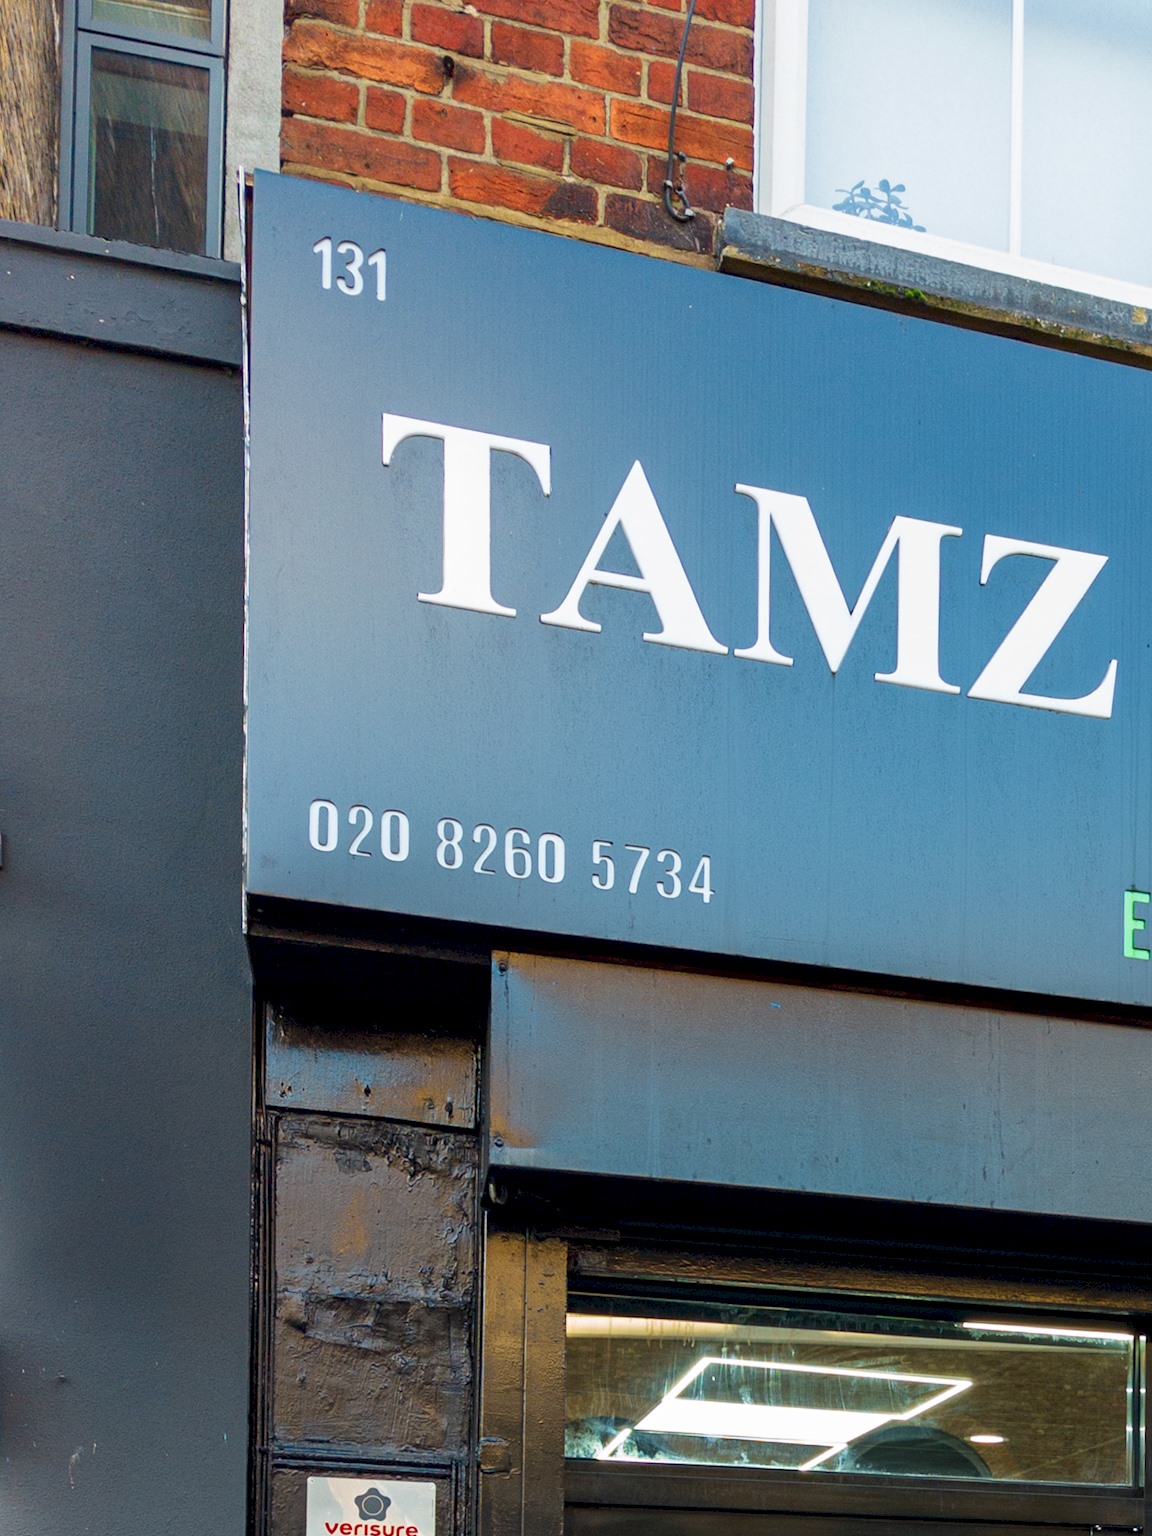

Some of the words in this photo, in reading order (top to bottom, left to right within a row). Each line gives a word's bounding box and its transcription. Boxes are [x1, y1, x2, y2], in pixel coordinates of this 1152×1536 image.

[311, 235, 389, 302] 131
[381, 412, 1118, 719] TAMZ
[307, 799, 410, 863] 020
[435, 817, 567, 884] 8260
[590, 840, 716, 904] 5734
